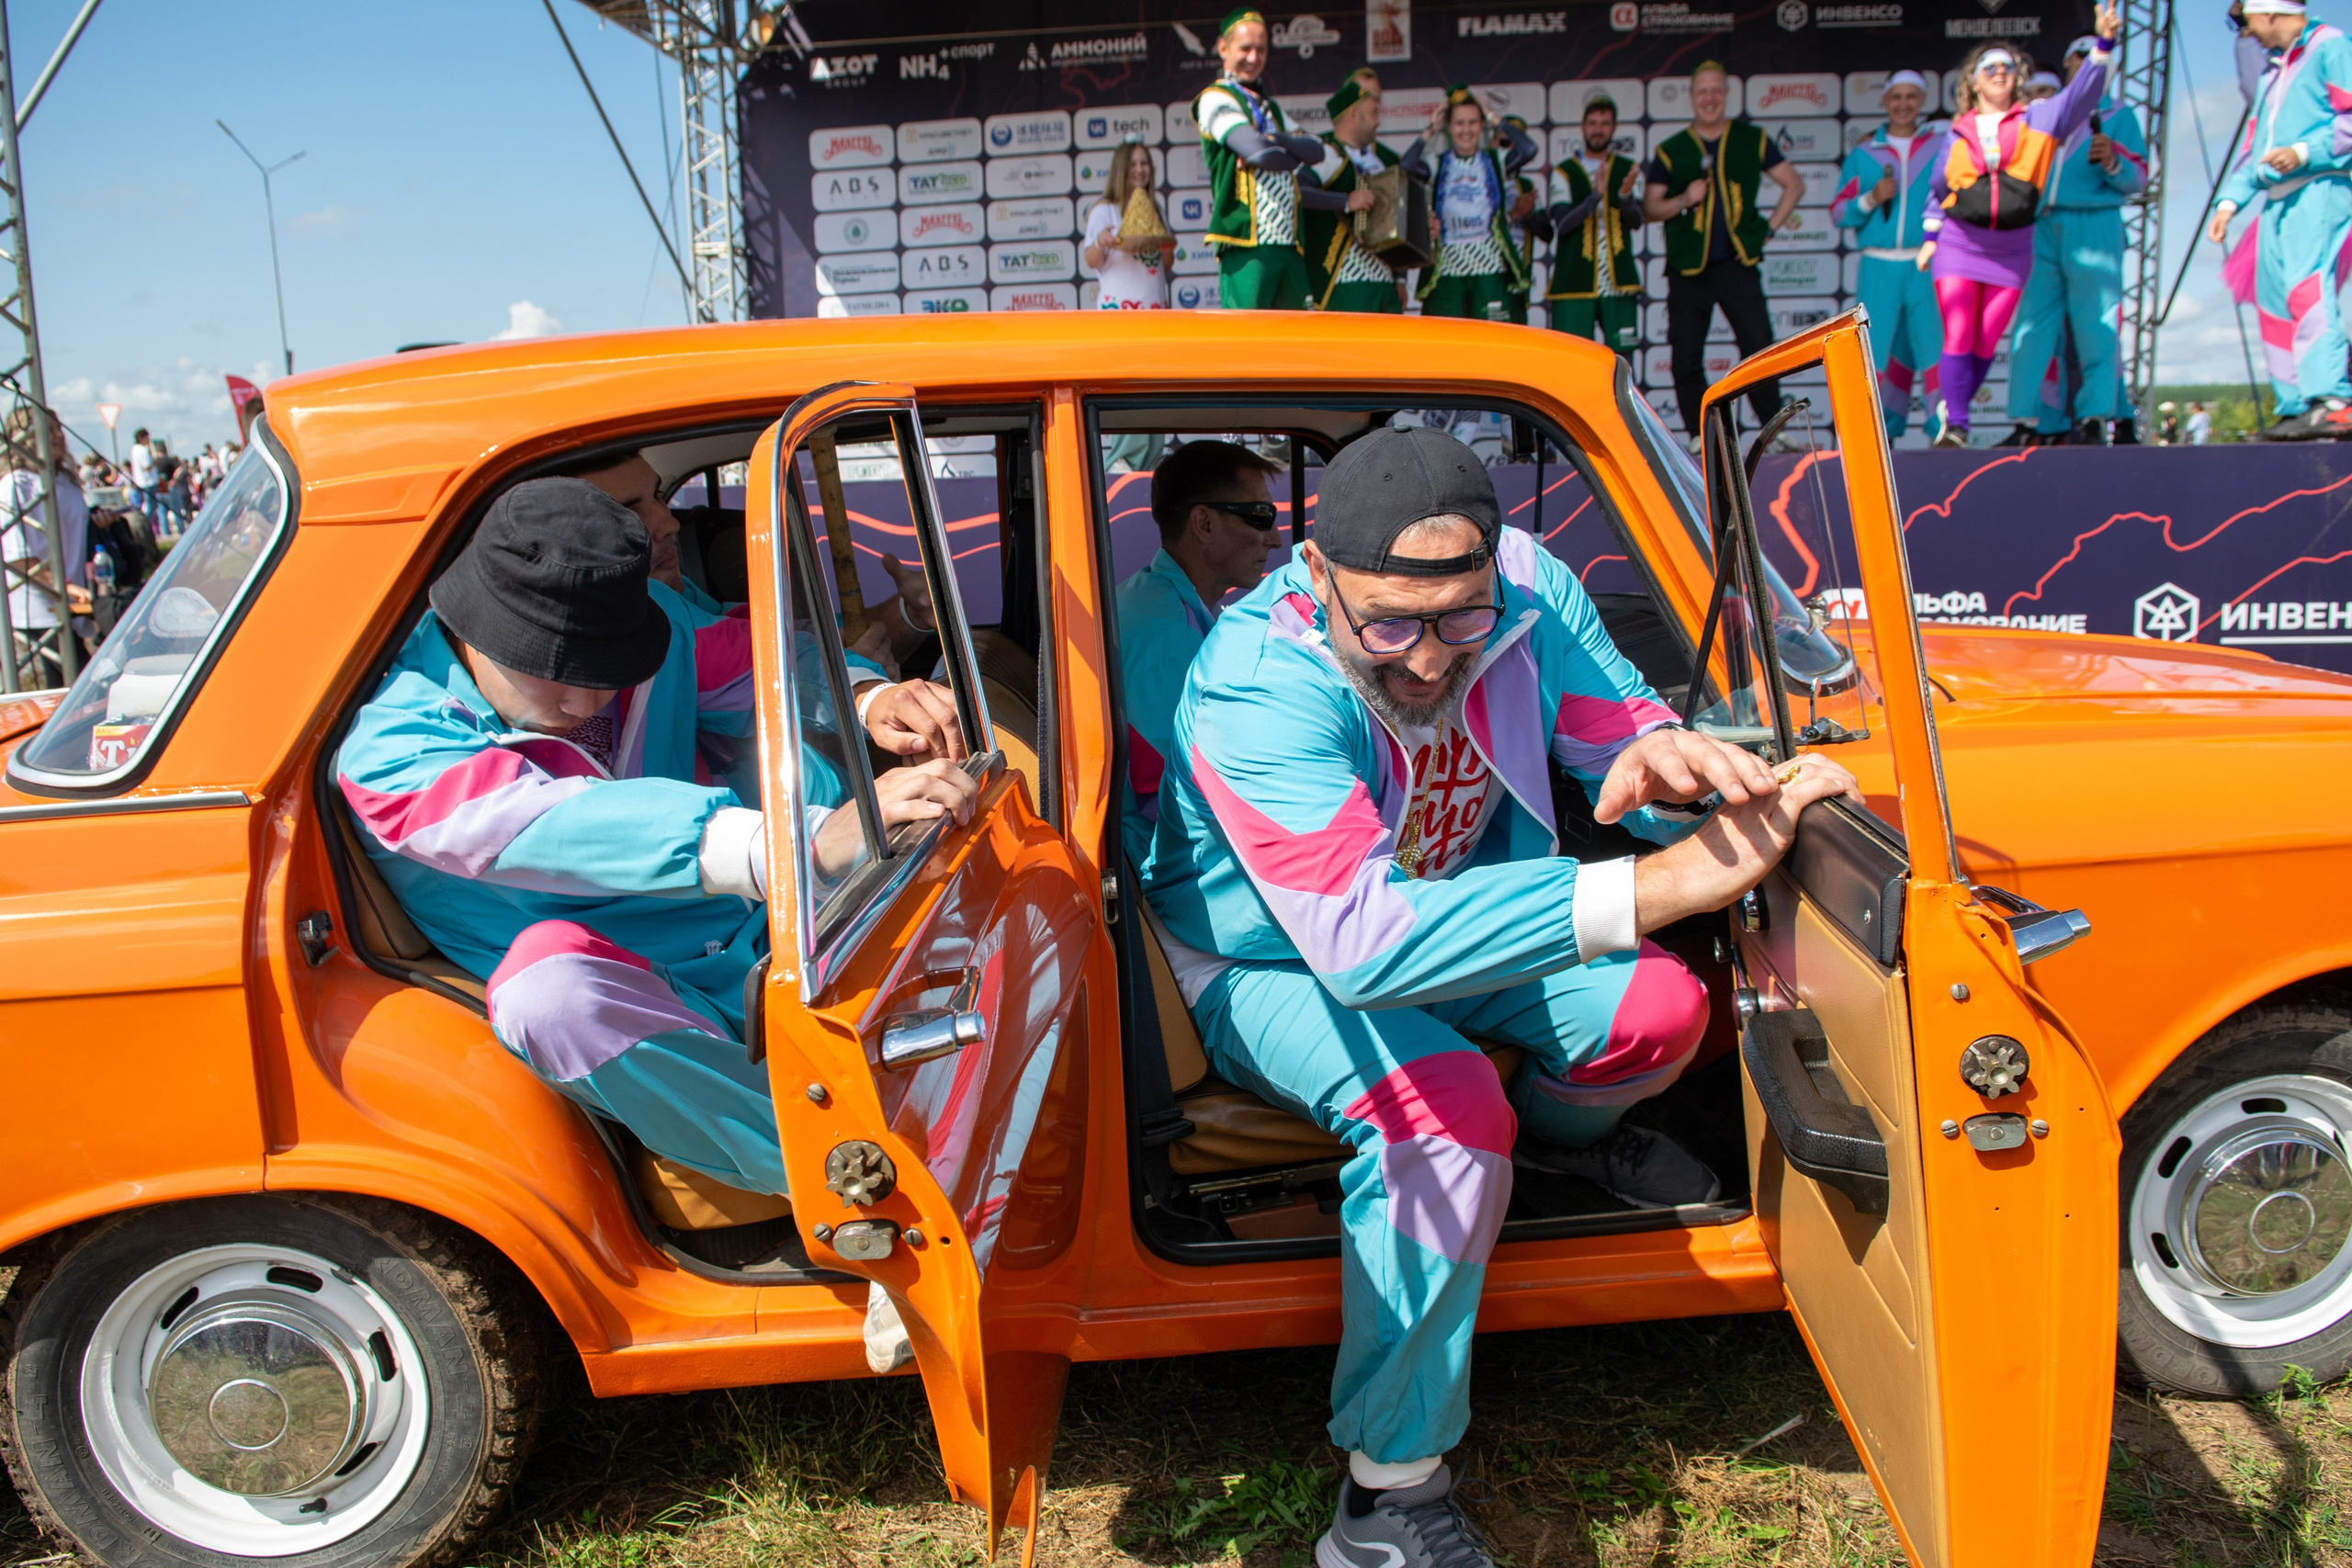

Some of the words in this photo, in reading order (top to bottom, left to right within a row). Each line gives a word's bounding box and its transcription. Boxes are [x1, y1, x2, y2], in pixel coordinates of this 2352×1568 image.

[1050, 33, 1148, 59] АММОНИЙ
[1113, 118, 1149, 132] tech
[1915, 591, 1987, 615] ЛЬФА
